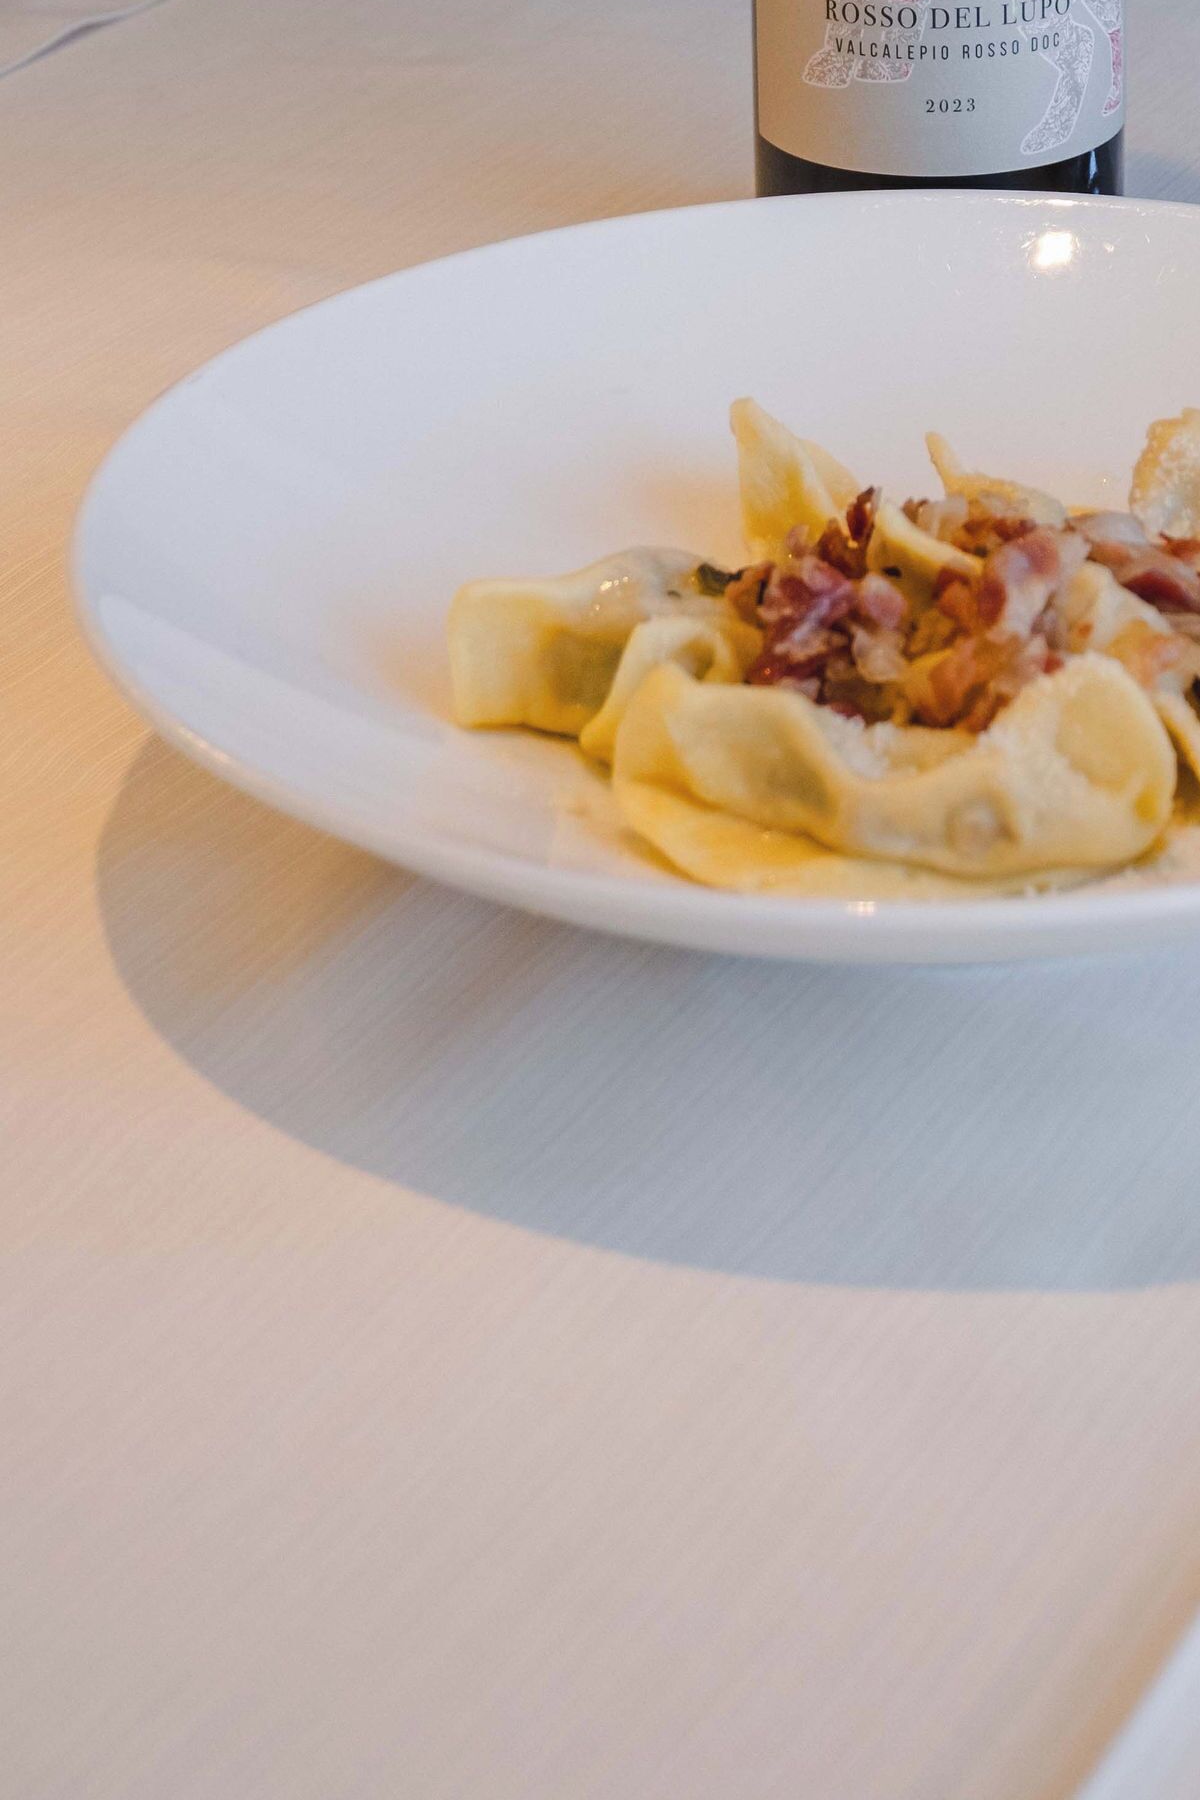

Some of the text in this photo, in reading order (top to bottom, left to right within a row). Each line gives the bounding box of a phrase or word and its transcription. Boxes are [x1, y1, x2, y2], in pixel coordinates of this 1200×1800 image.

[930, 6, 991, 30] DEL
[835, 32, 1061, 61] VALCALEPIO ROSSO DOC
[925, 97, 976, 114] 2023
